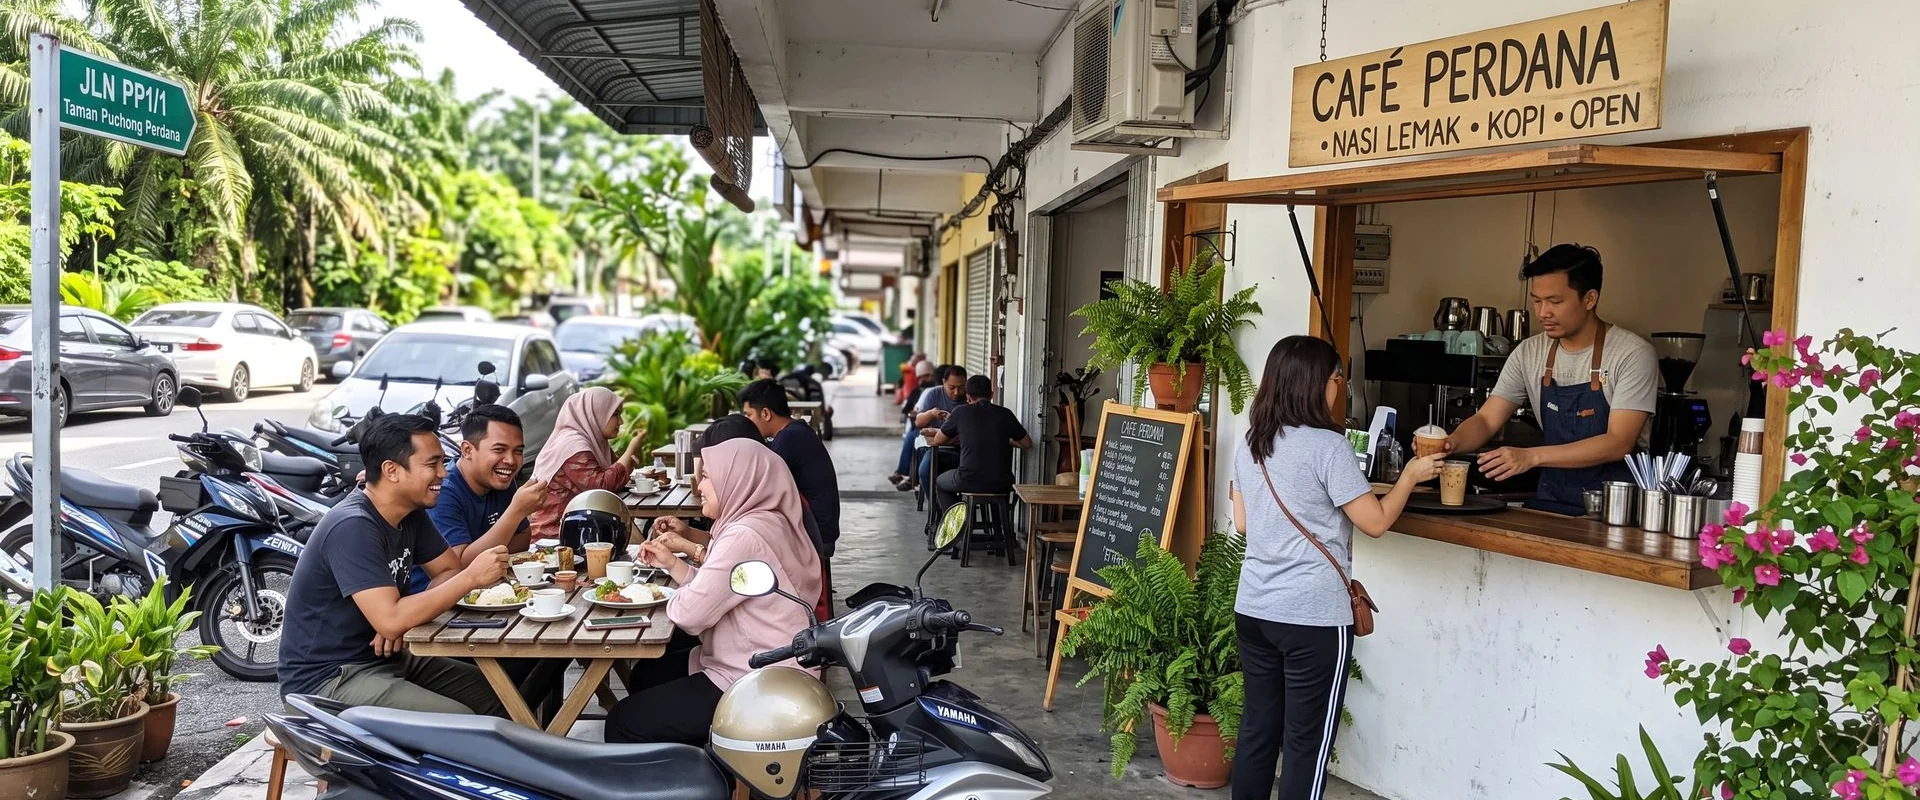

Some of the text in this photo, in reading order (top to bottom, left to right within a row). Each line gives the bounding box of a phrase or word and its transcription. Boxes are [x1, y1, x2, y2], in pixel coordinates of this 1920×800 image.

[80, 66, 166, 116] JLN PP1/1
[1312, 21, 1620, 122] CAFÉ PERDANA
[63, 97, 181, 142] Taman Puchong Perdana
[1332, 91, 1640, 158] NASI LEMAK KOPI OPEN
[937, 705, 978, 726] YAMAHA
[755, 741, 787, 752] YAMAHA
